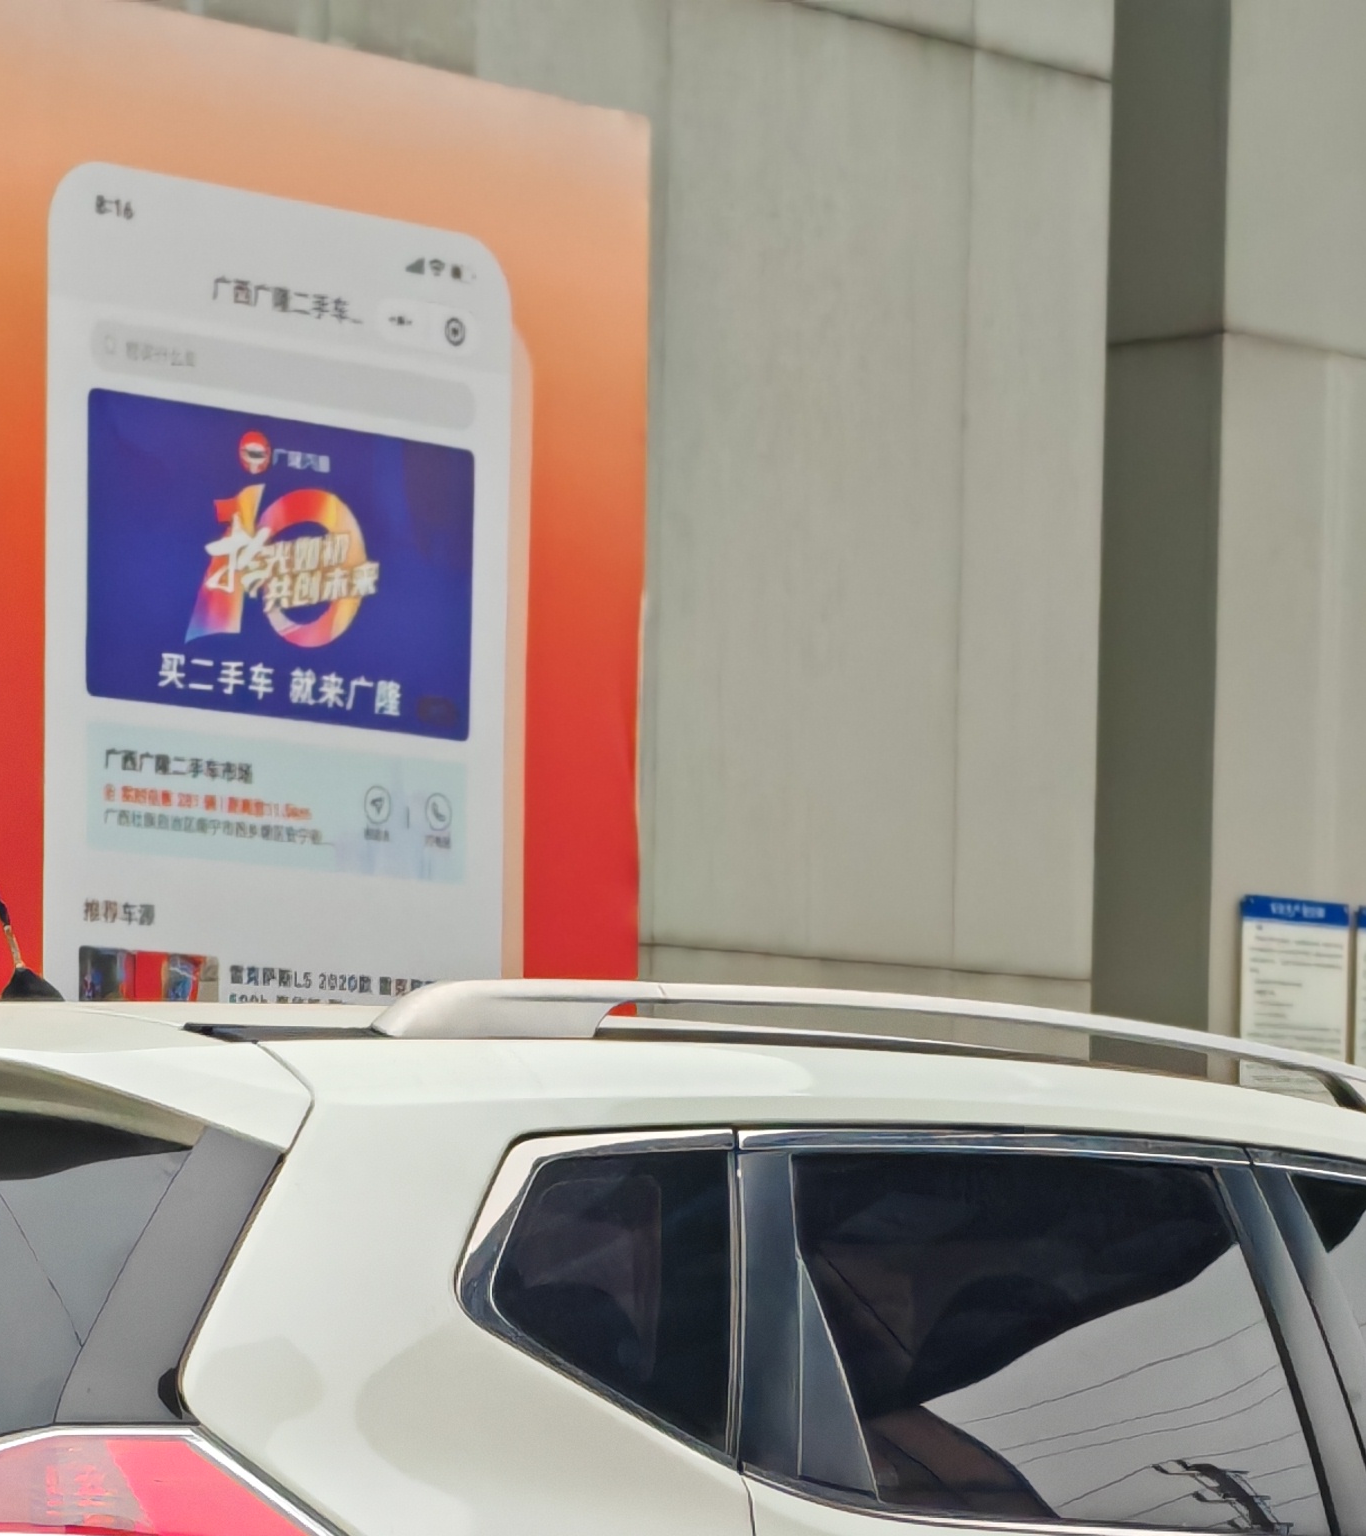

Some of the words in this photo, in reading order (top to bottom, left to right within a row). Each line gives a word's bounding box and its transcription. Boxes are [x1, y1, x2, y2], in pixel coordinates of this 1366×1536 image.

[158, 652, 275, 699] 买二手车
[289, 667, 402, 716] 就来广隆
[83, 898, 156, 927] 推荐车源
